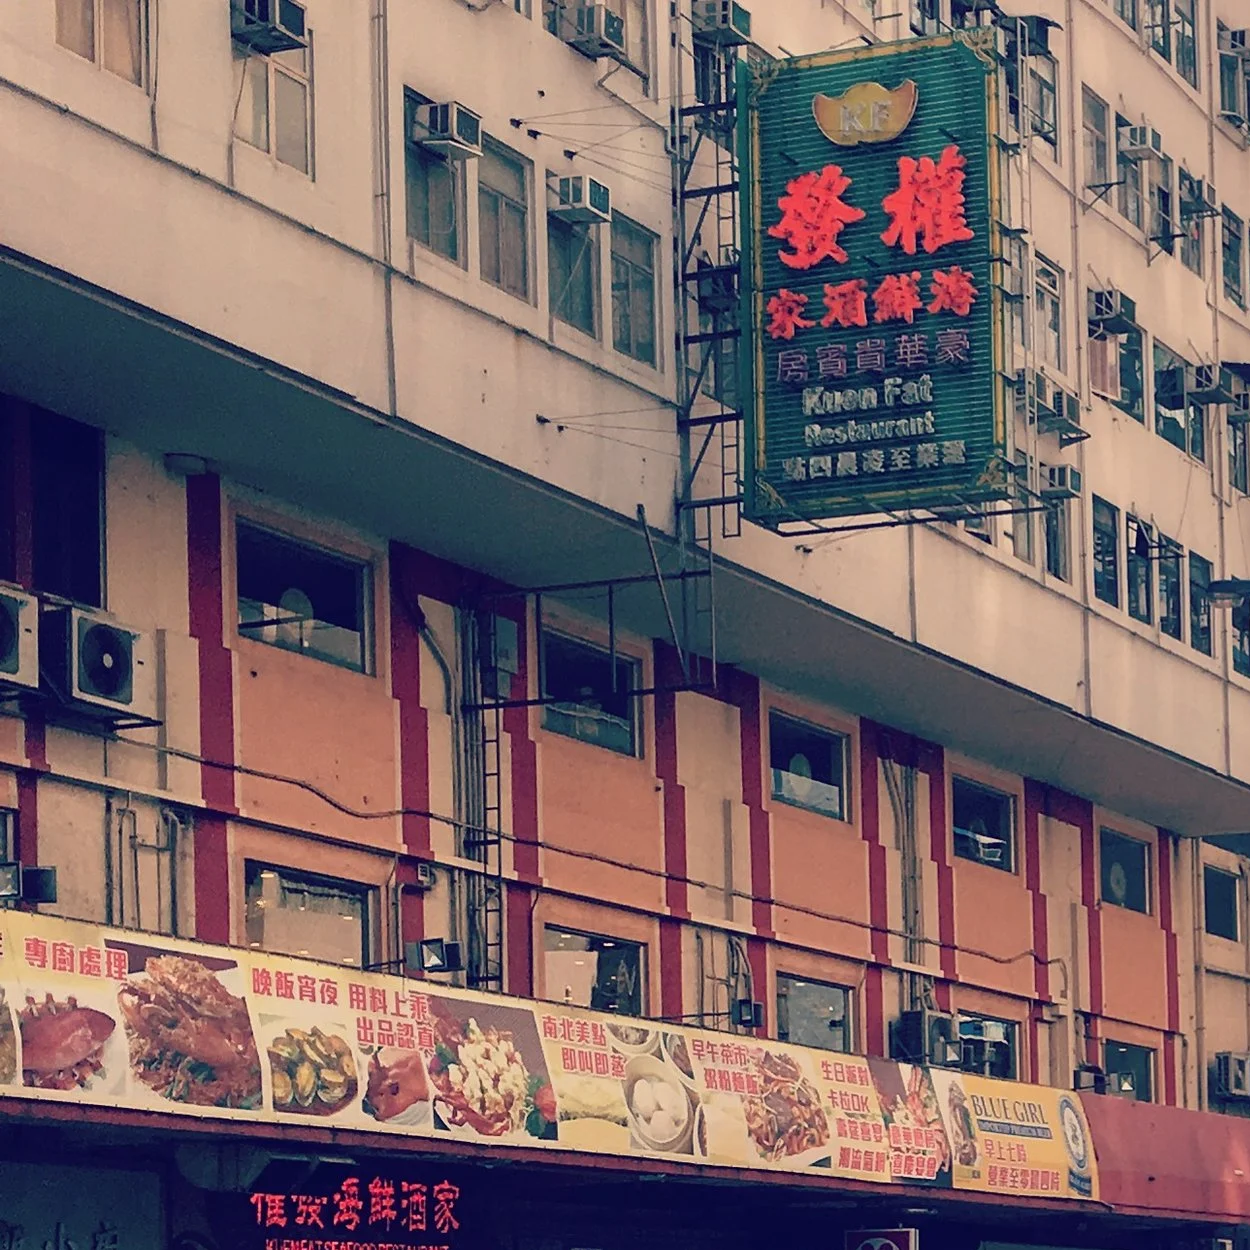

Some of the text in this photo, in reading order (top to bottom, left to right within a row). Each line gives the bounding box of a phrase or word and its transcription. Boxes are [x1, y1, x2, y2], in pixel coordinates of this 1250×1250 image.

[841, 101, 892, 136] KF
[802, 373, 934, 415] Kuen Fat
[804, 410, 935, 447] Restaurant
[252, 967, 339, 1006] 晚飯宵夜
[542, 1015, 607, 1048] 南北美點
[827, 1089, 870, 1113] 卡拉OK
[971, 1094, 1049, 1125] BLUE GIRL
